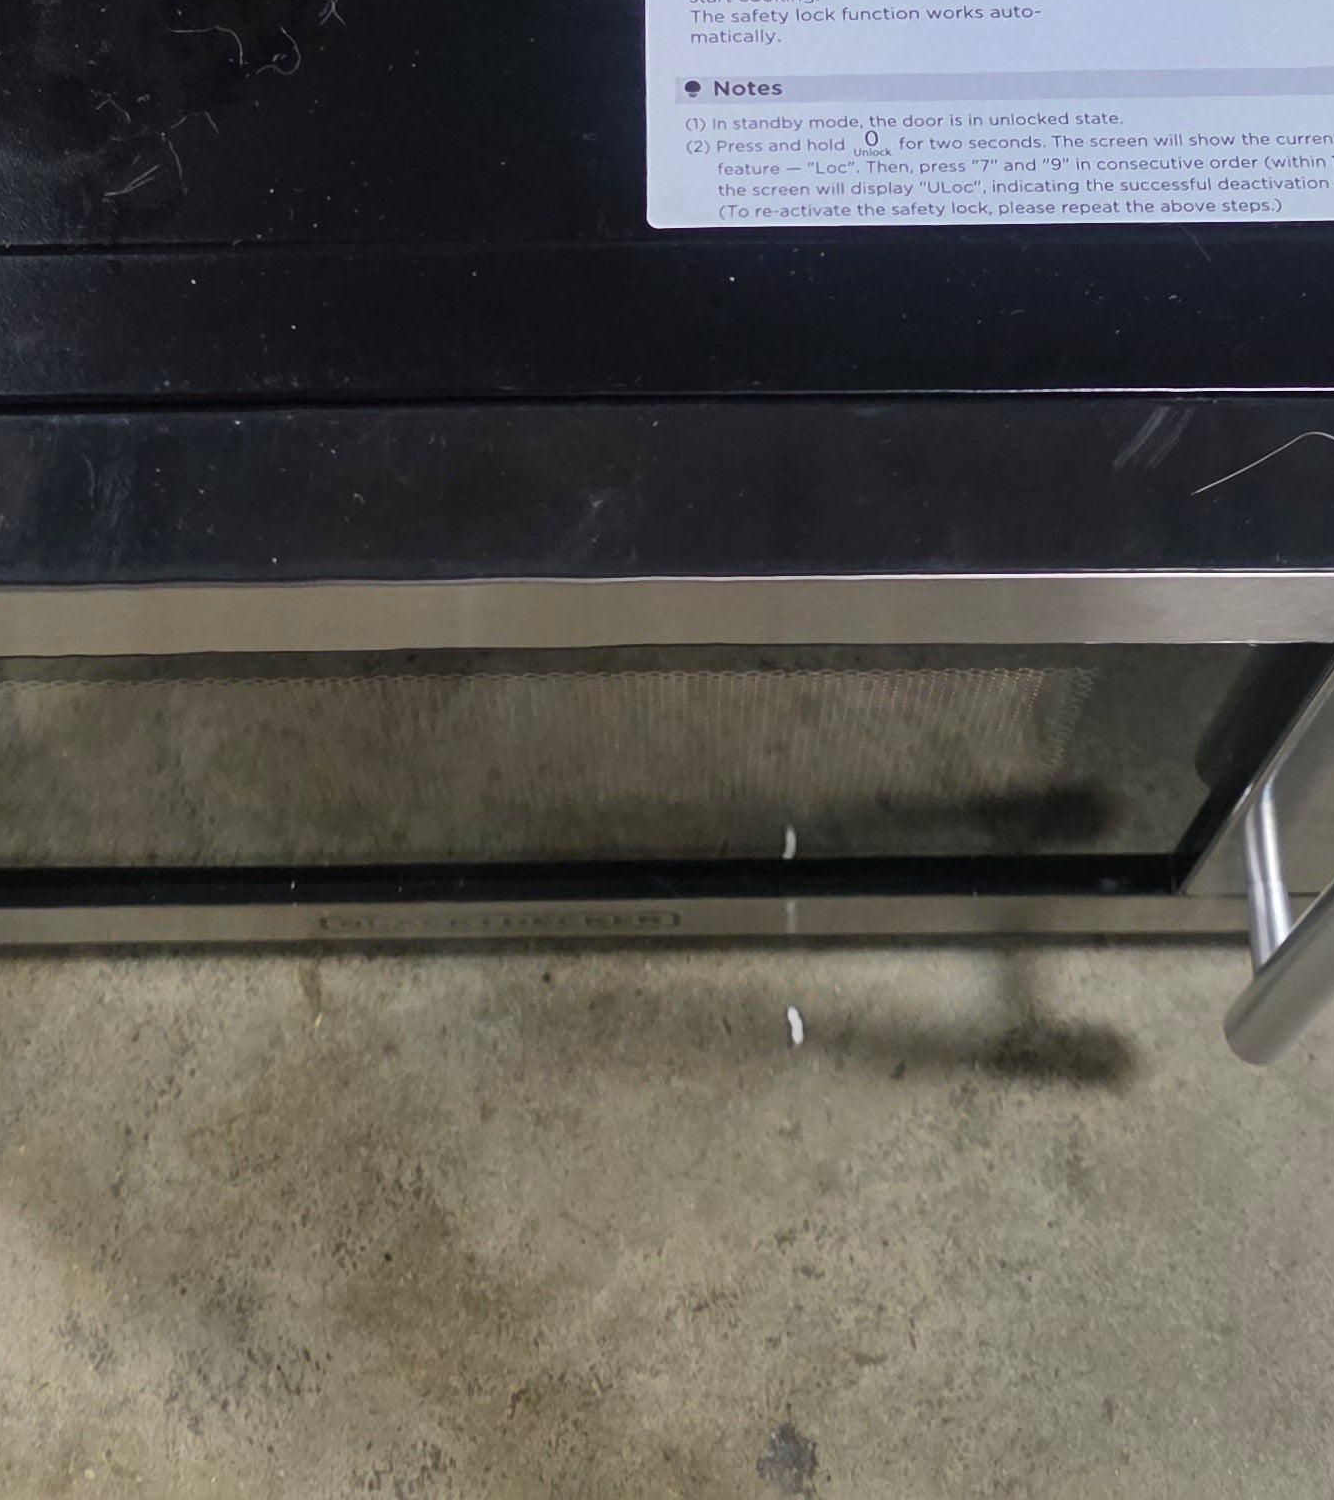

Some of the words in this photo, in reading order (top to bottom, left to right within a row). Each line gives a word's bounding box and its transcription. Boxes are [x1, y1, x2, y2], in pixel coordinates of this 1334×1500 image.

[689, 8, 725, 23] The
[730, 7, 789, 25] safety
[795, 6, 836, 22] lock
[841, 5, 920, 21] function
[925, 4, 984, 20] works
[989, 5, 1041, 19] auto-
[690, 28, 781, 45] matically.
[712, 79, 783, 97] Notes
[684, 116, 706, 132] (1)
[711, 117, 727, 130] In
[732, 115, 803, 132] standby
[808, 114, 864, 130] mode,
[868, 114, 897, 128] the
[901, 113, 944, 128] door
[949, 113, 963, 127] is
[967, 115, 983, 126] in
[988, 111, 1069, 126] unlocked
[1074, 112, 1124, 125] state.
[685, 139, 710, 155] (2)
[715, 139, 763, 153] Press
[767, 138, 801, 152] and
[806, 137, 845, 151] hold
[898, 135, 924, 150] for
[928, 137, 963, 150] two
[967, 134, 1046, 149] seconds.
[1050, 133, 1084, 148] The
[1088, 136, 1148, 148] screen
[1152, 132, 1183, 147] will
[1187, 132, 1236, 147] show
[1240, 131, 1270, 146] the
[852, 146, 892, 157] Unlock
[717, 161, 780, 175] feature
[865, 159, 914, 174] Then,
[918, 161, 966, 175] press
[1002, 157, 1036, 172] and
[1075, 156, 1091, 171] in
[1095, 155, 1204, 171] consecutive
[1208, 154, 1258, 169] order
[1263, 154, 1326, 170] (within
[717, 182, 746, 197] the
[752, 184, 810, 197] screen
[814, 181, 845, 195] will
[849, 180, 914, 198] display
[991, 178, 1080, 196] indicating
[1085, 177, 1114, 192] the
[1119, 176, 1212, 192] successful
[1216, 175, 1330, 191] deactivation
[718, 203, 749, 220] (To
[754, 204, 852, 218] re-activate
[856, 202, 886, 216] the
[890, 201, 946, 217] safety
[950, 200, 993, 216] lock,
[997, 200, 1056, 217] please
[1060, 199, 1120, 216] repeat
[1124, 199, 1155, 213] the
[1159, 198, 1216, 213] above
[1220, 197, 1282, 214] steps.)
